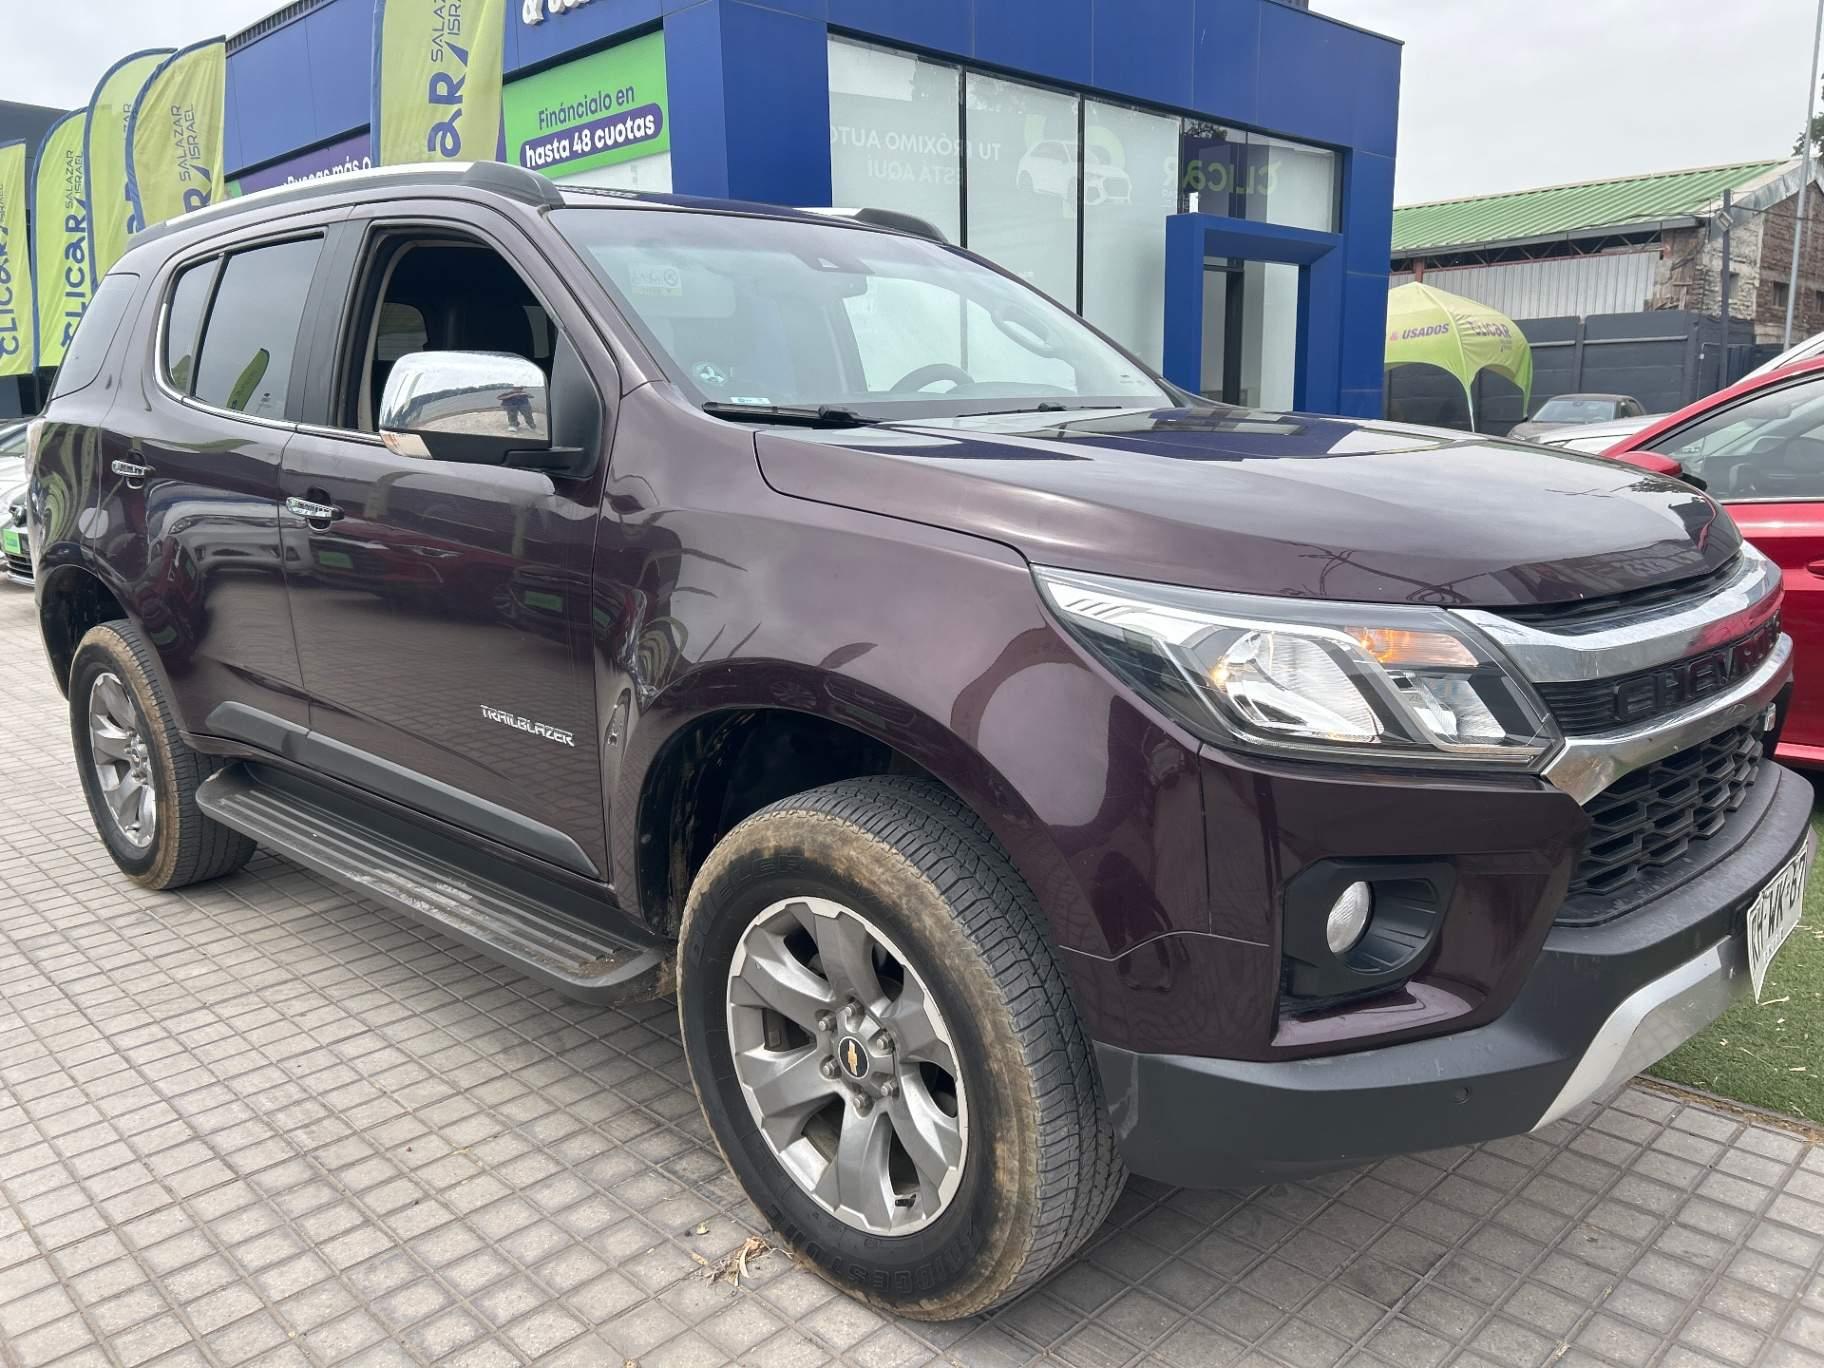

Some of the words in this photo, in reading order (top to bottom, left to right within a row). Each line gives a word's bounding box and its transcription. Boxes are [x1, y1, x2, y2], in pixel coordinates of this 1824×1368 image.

[431, 0, 446, 63] SALA
[447, 0, 462, 35] ISR
[184, 104, 201, 160] ISRAEL
[538, 91, 612, 130] Fináncialo
[615, 86, 635, 106] en
[171, 104, 191, 182] SALAZAR
[525, 137, 571, 168] hasta
[572, 128, 592, 154] 48
[594, 114, 656, 150] cuotas
[65, 150, 73, 209] SALAZAR
[1402, 323, 1449, 340] USADOS
[480, 704, 575, 747] TRAILBLAZER
